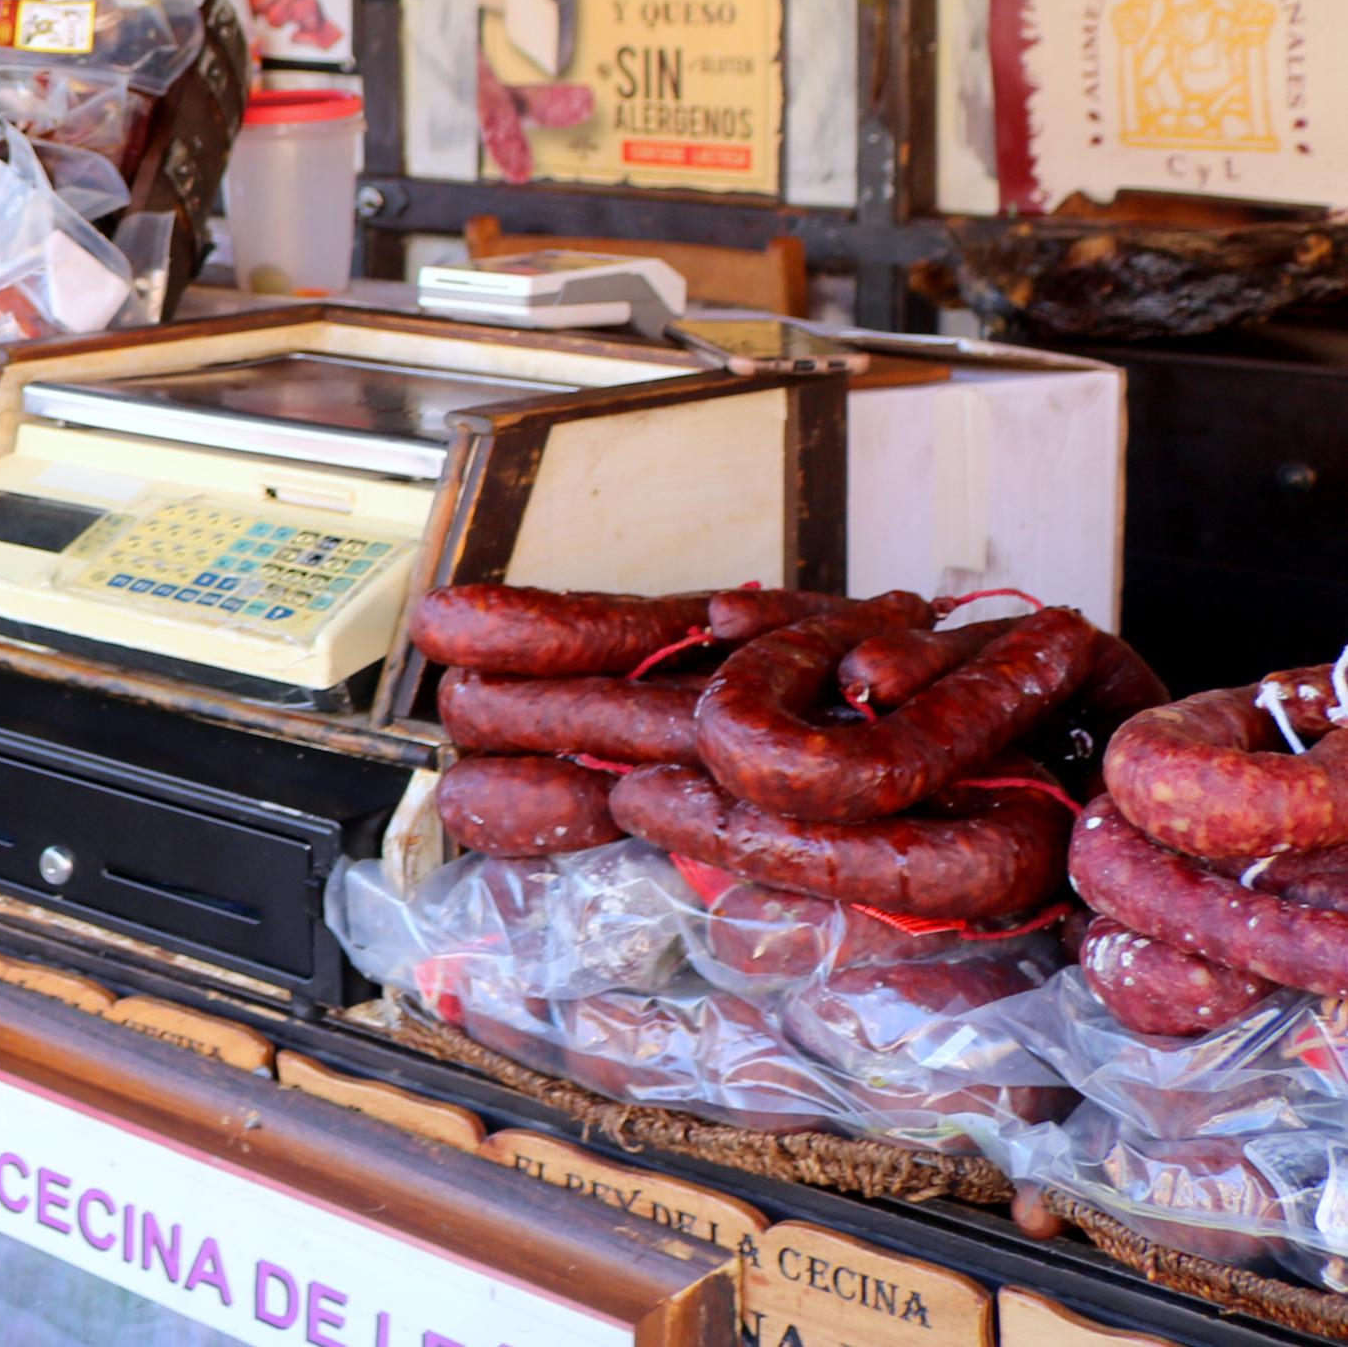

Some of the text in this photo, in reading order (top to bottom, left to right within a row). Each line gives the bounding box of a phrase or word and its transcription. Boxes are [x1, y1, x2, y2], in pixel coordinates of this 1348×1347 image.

[612, 0, 737, 29] Y QUESO
[614, 45, 683, 101] SIN
[253, 1258, 348, 1347] DE
[777, 1245, 934, 1330] CECINA
